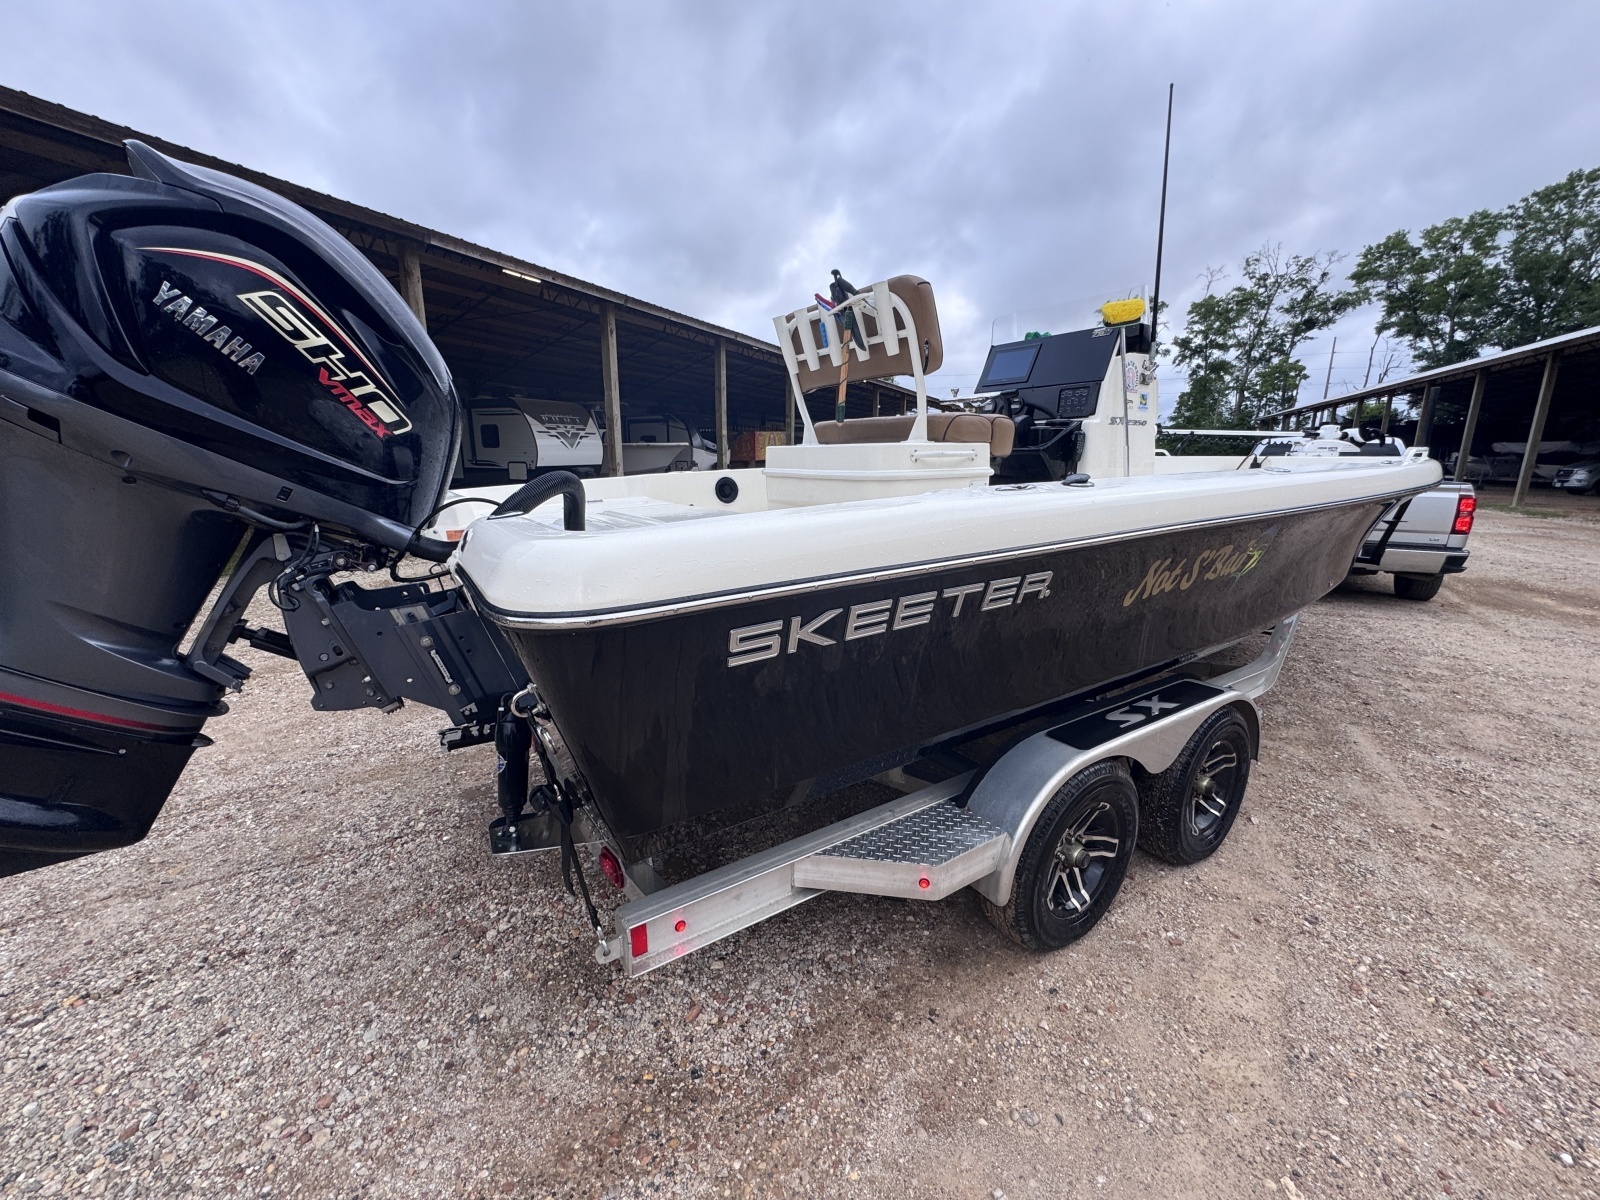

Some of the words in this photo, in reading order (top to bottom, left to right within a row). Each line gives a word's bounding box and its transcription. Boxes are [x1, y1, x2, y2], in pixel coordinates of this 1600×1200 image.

[152, 280, 266, 376] YAMAHA
[1122, 557, 1188, 607] Not
[726, 570, 1053, 668] SKEETER
[1105, 694, 1181, 728] SX
